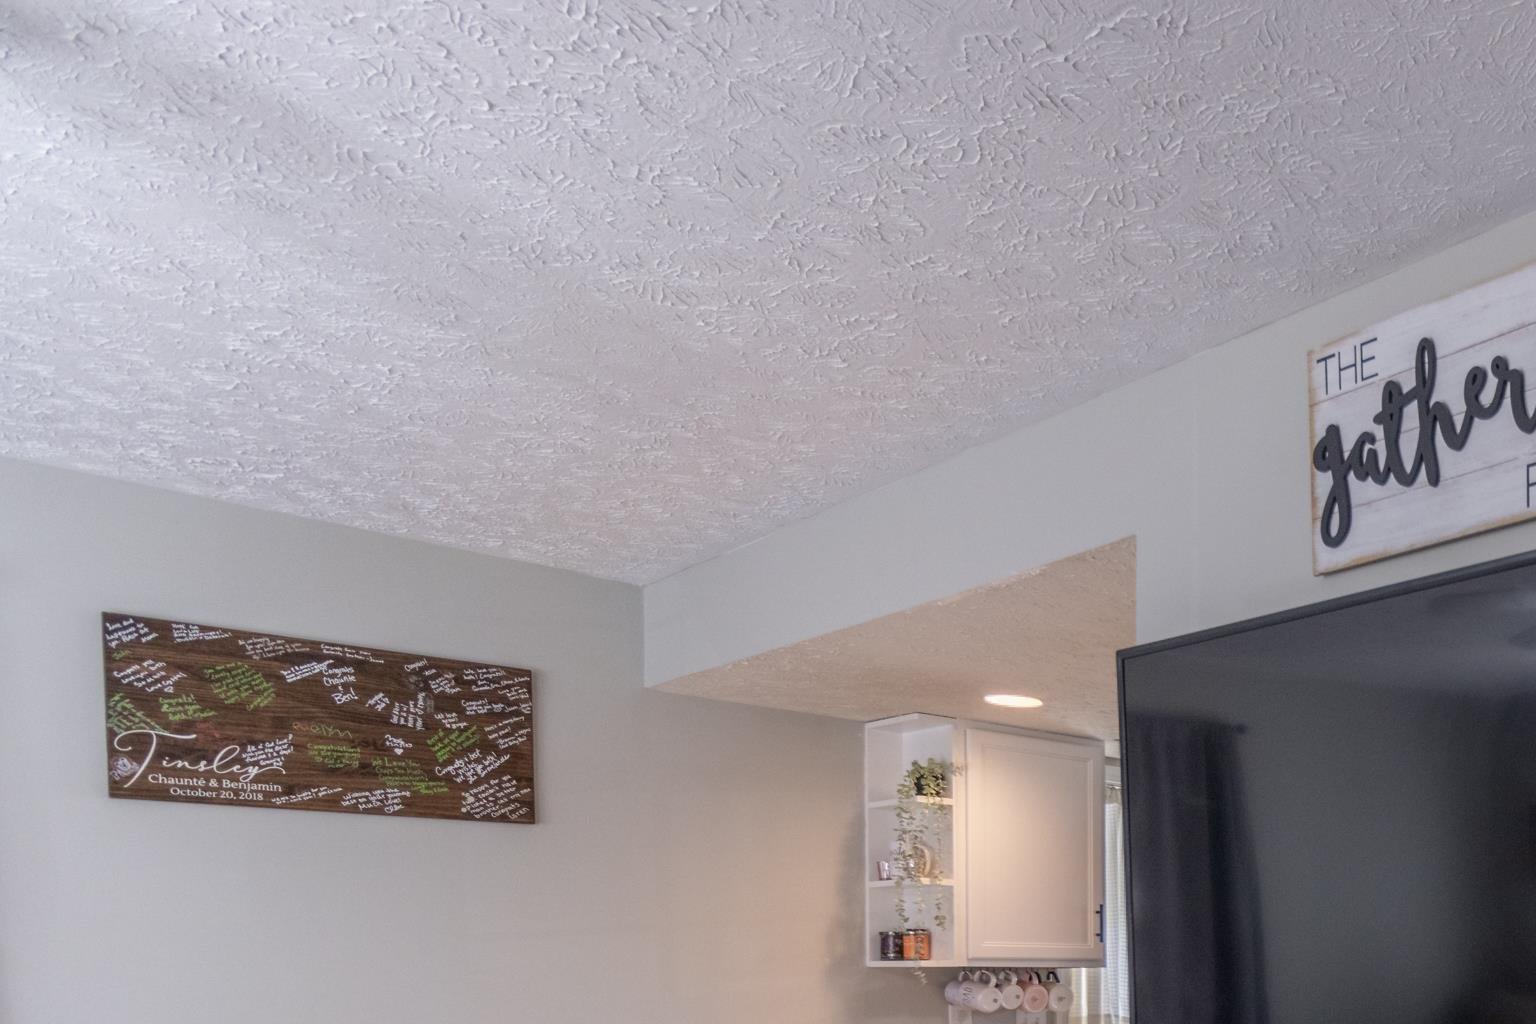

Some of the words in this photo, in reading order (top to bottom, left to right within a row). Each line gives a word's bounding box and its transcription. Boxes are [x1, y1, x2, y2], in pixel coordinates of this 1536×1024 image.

[1316, 336, 1379, 396] THE
[113, 729, 286, 788] Tinsley
[148, 773, 206, 787] Chaunté
[208, 778, 219, 788] &
[222, 778, 282, 793] Benjamin
[170, 787, 217, 798] October
[220, 790, 236, 800] 20,
[238, 791, 264, 801] 2018
